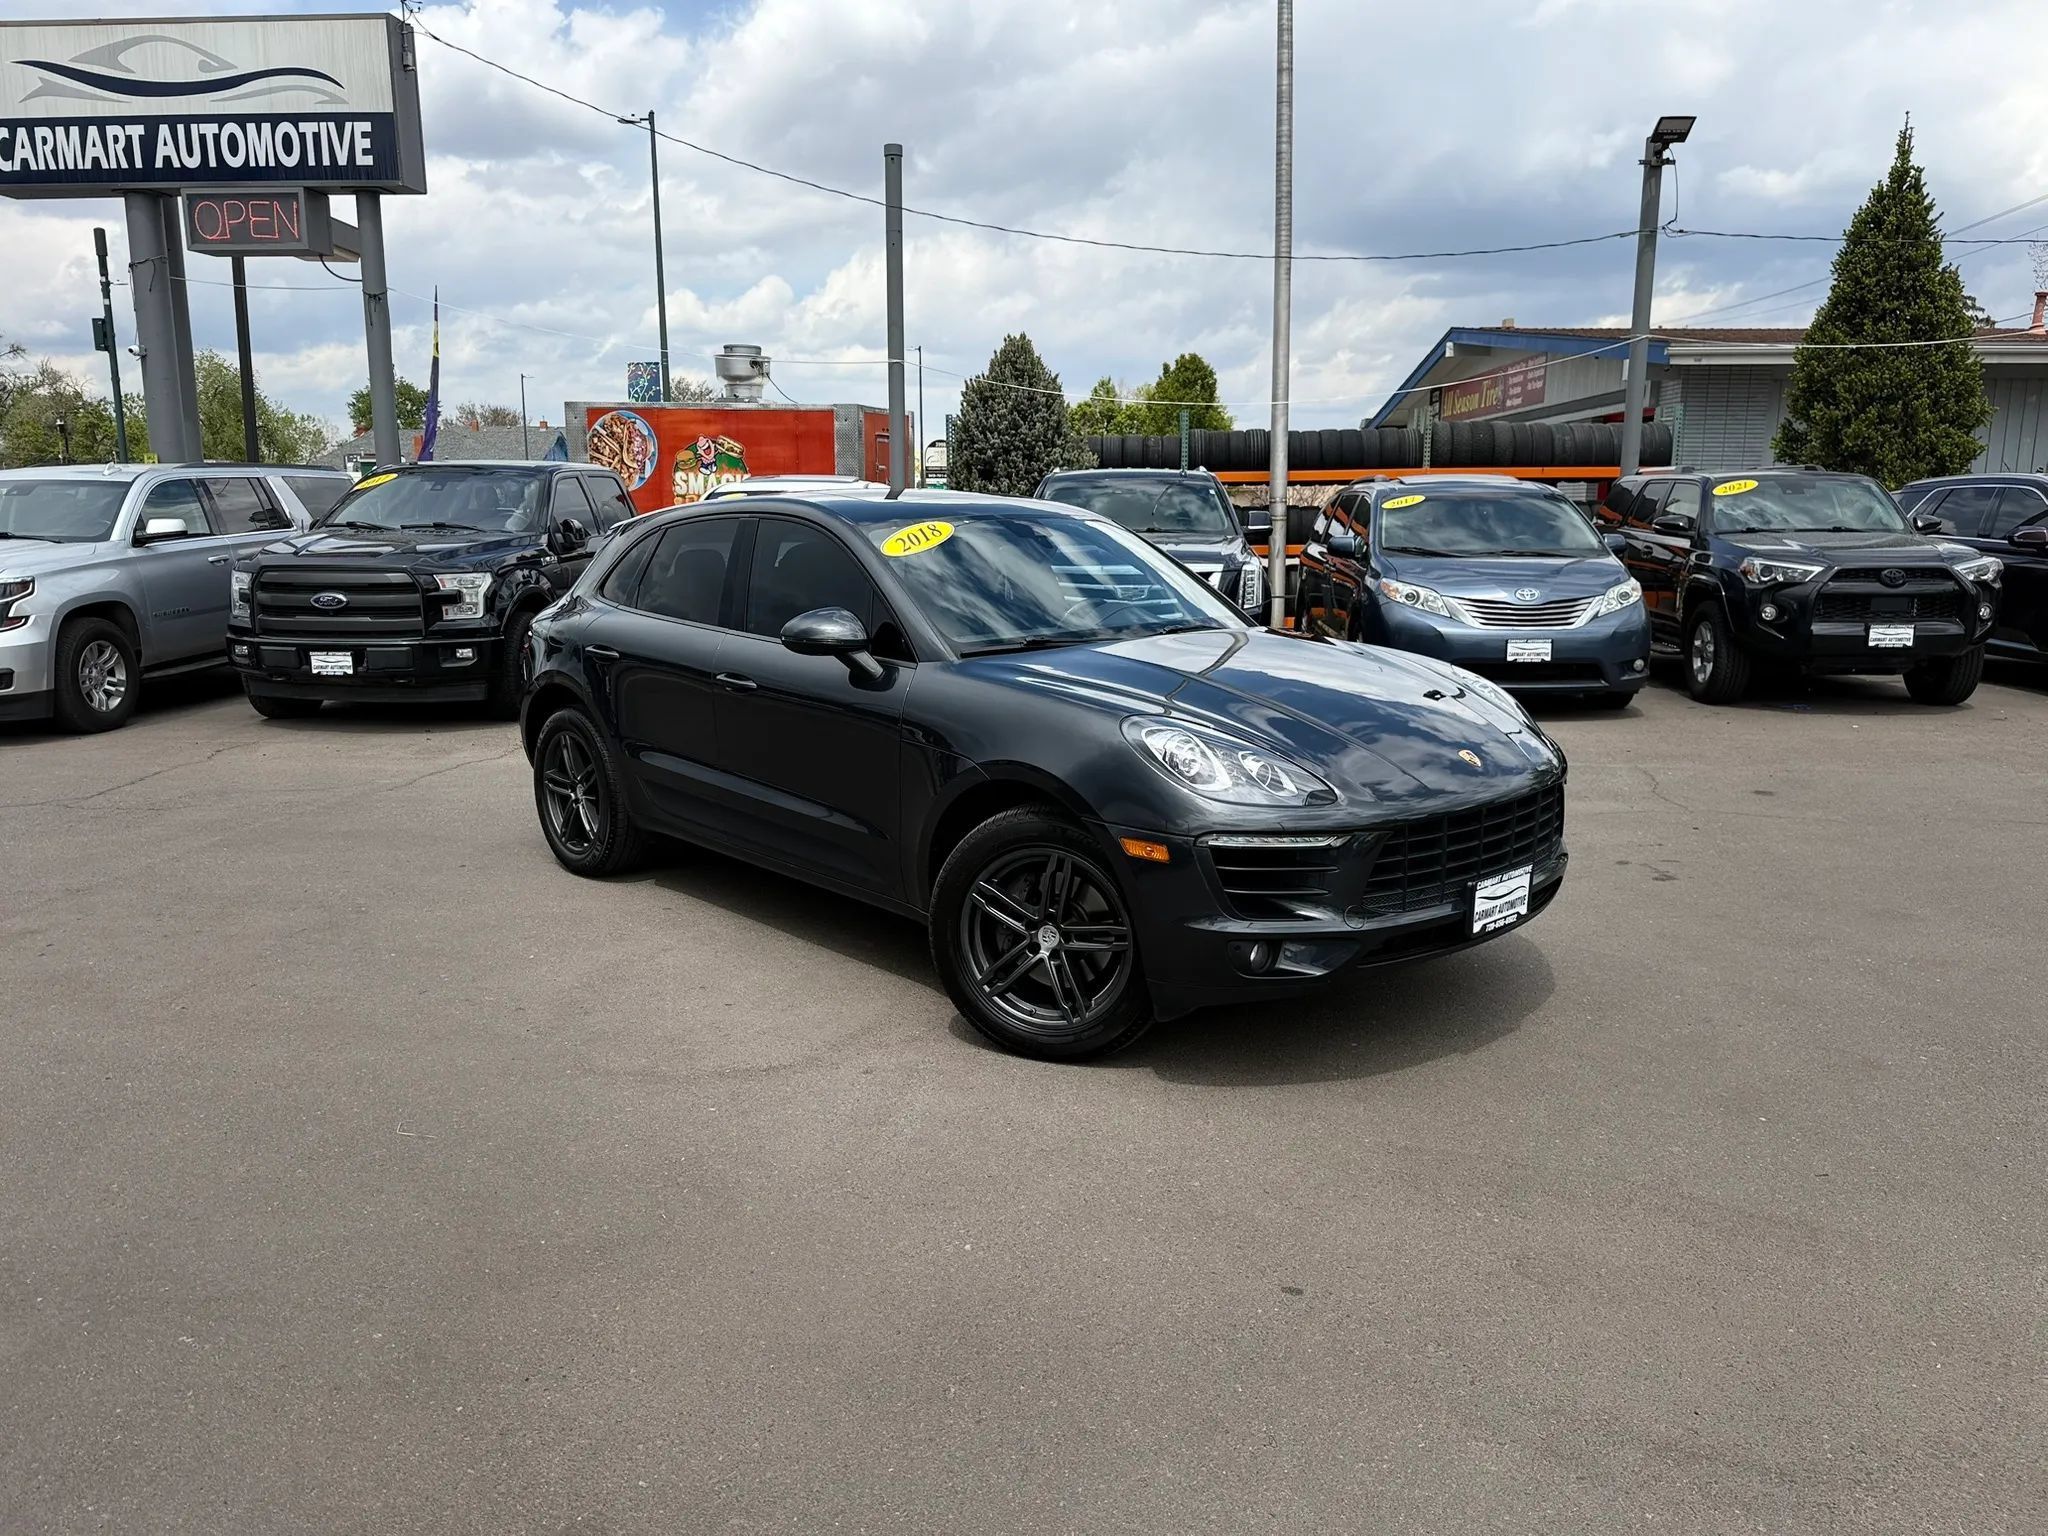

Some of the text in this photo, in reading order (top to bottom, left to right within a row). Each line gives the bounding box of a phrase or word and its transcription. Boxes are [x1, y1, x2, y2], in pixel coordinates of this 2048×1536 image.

[0, 121, 374, 171] CARMART AUTOMOTIVE
[194, 200, 298, 240] OPEN
[1391, 495, 1416, 508] 2017
[1721, 481, 1748, 494] 2021
[895, 523, 943, 553] 2018
[1477, 875, 1502, 890] CARMART
[1474, 905, 1498, 923] CARMART
[1498, 894, 1527, 914] AUTOMOTIVE
